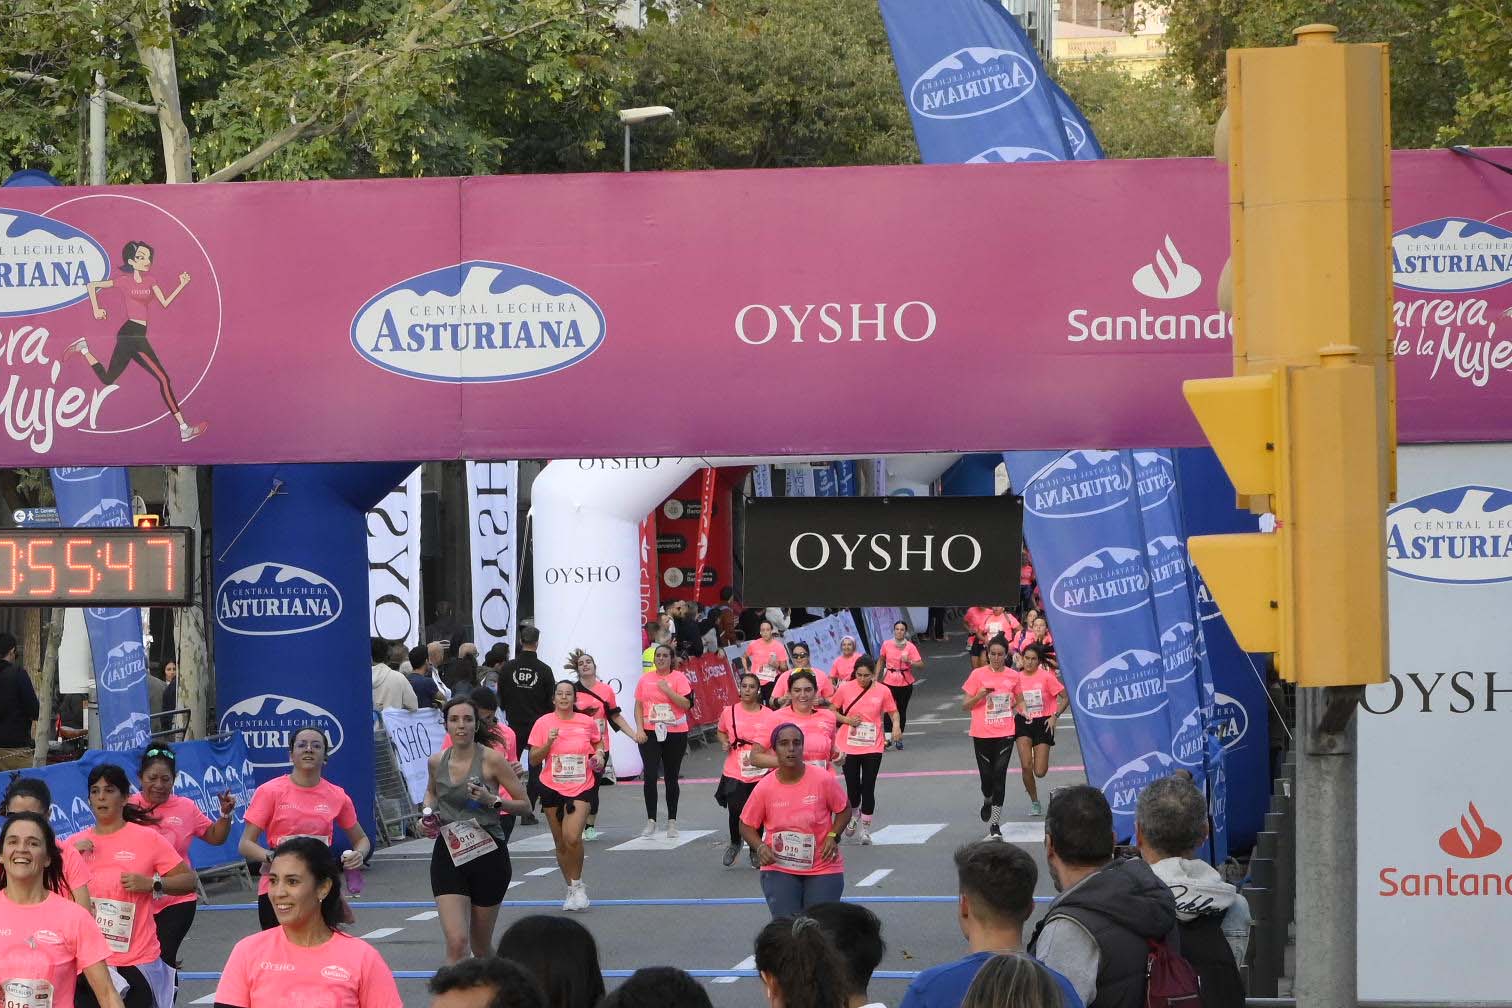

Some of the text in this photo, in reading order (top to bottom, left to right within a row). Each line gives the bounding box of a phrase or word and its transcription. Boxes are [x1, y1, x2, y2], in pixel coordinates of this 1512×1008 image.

[13, 244, 86, 256] LECHERA
[1407, 243, 1458, 251] CENTRAL
[409, 302, 578, 317] CENTRAL LECHERA
[1393, 298, 1488, 328] arrera
[370, 308, 587, 354] ASTURIANA
[734, 301, 938, 345] OYSHO
[1068, 309, 1234, 342] Santand
[1416, 328, 1434, 355] la
[1414, 520, 1481, 530] CENTRAL
[789, 532, 982, 573] OYSHO
[545, 565, 621, 585] OYSHO
[232, 587, 328, 596] CENTRAL LECHERA
[220, 592, 333, 620] ASTURIANA
[519, 672, 532, 682] BP
[234, 718, 329, 728] CENTRAL LECHERA
[96, 916, 114, 927] 016
